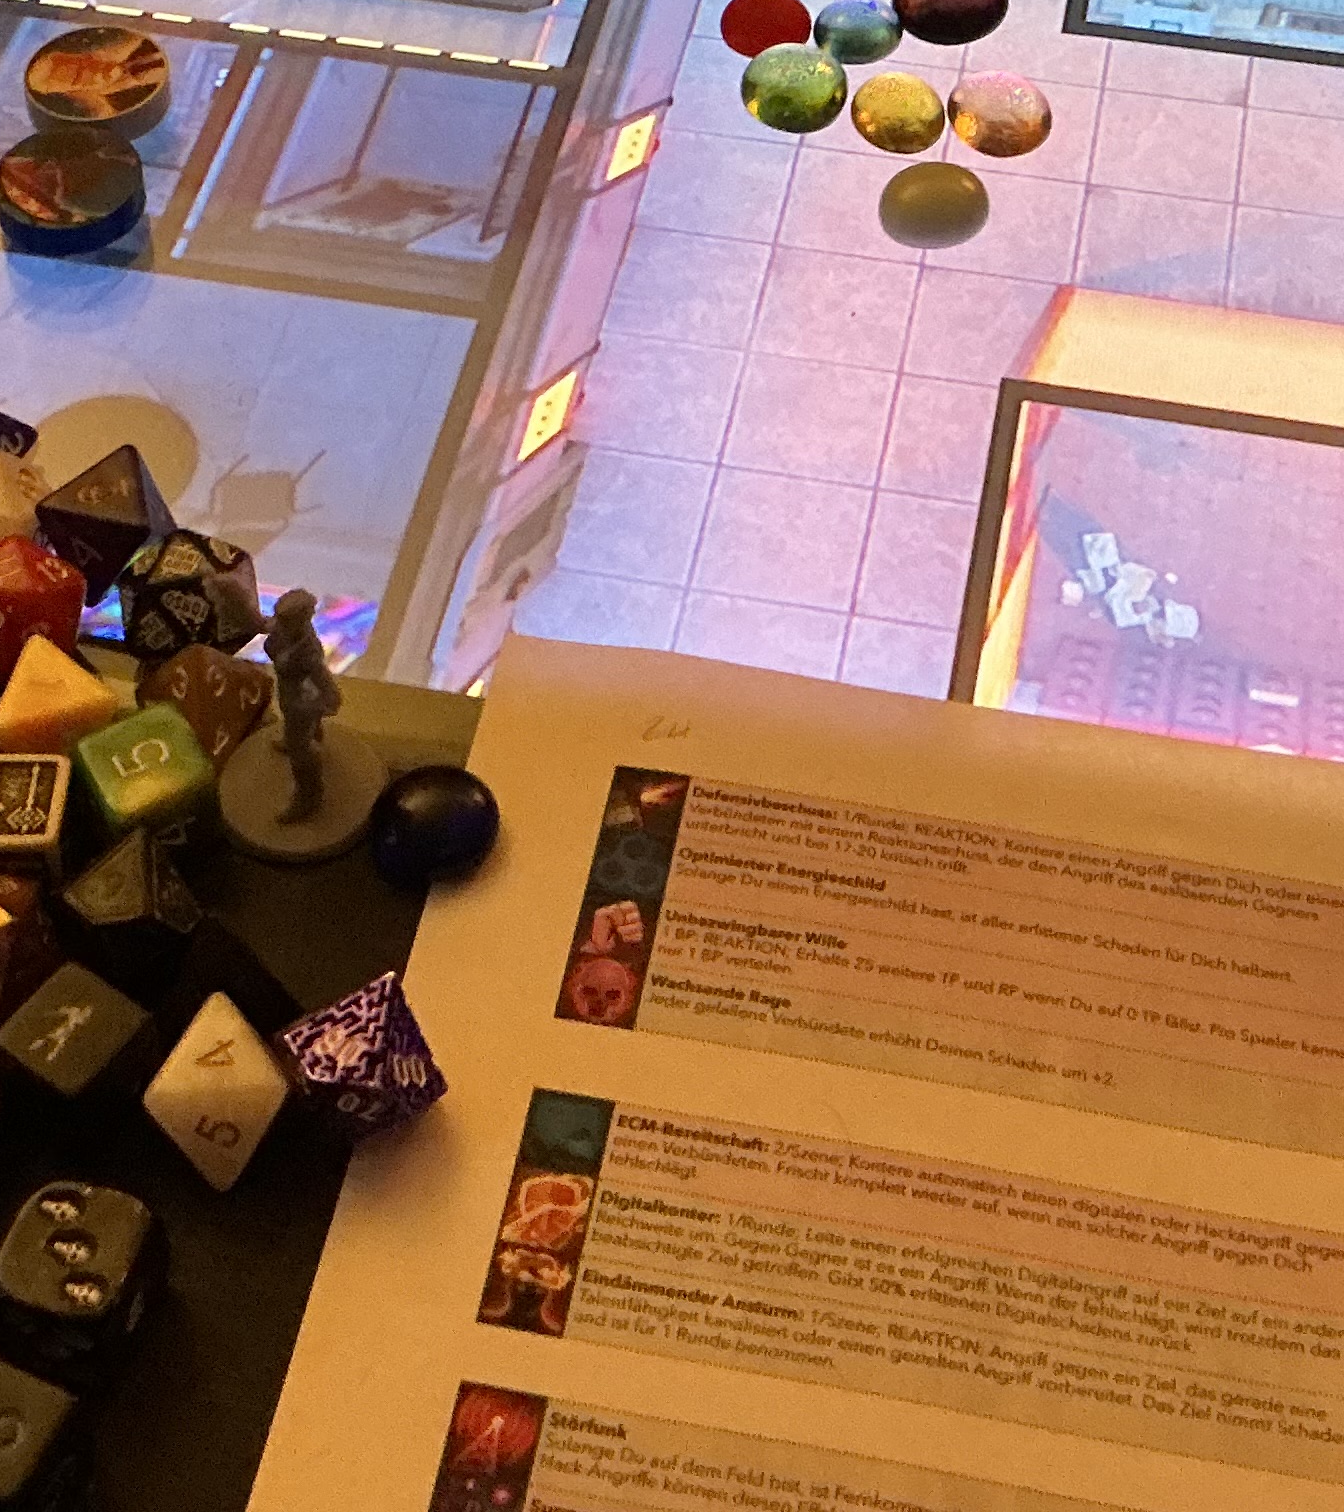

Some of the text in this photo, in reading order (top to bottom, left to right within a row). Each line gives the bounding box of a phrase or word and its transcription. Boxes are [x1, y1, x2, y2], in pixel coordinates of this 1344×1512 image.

[111, 737, 172, 778] 5
[1226, 876, 1260, 893] Dich
[1191, 951, 1227, 968] Dich
[194, 1112, 244, 1151] 5
[1273, 1254, 1313, 1273] Dich
